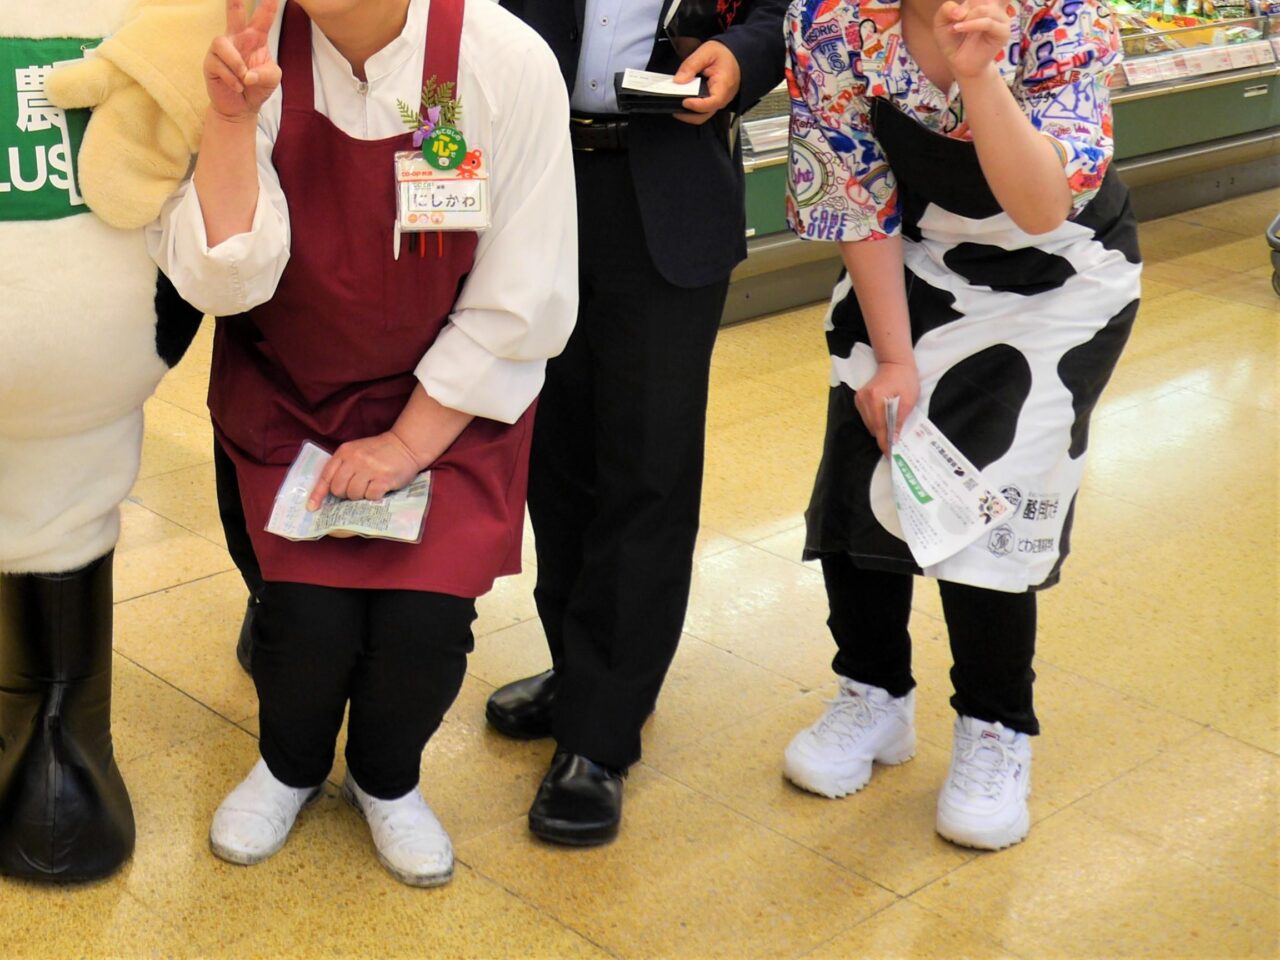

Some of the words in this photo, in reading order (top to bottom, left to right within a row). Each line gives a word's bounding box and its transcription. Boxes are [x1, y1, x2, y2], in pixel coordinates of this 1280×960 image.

[413, 193, 476, 208] にしかわ
[809, 208, 848, 228] GAME
[806, 222, 845, 241] OVER
